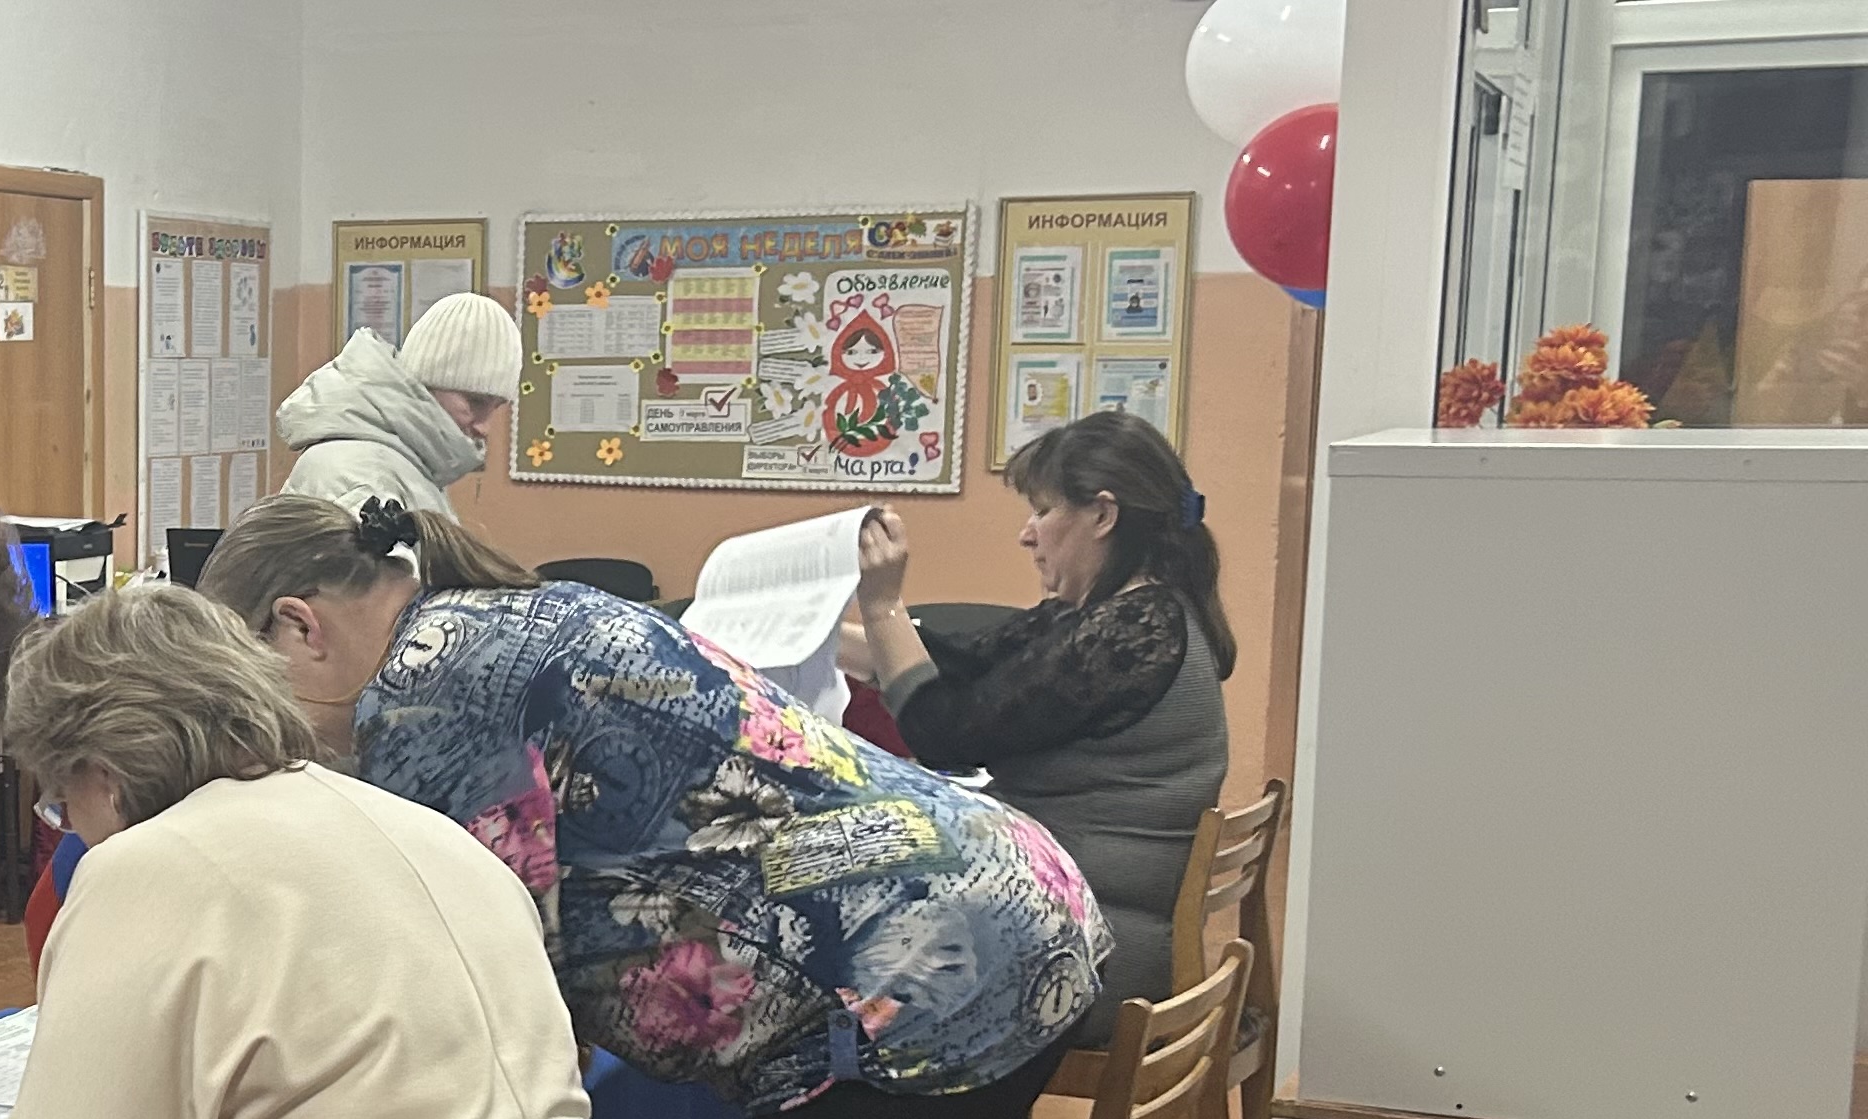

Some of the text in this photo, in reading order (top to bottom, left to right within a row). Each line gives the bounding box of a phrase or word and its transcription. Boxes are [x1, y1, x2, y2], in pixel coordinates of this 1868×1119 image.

[1027, 211, 1168, 230] ИНФОРМАЦИЯ
[354, 234, 466, 251] ИНФОРМАЦИЯ
[659, 229, 863, 262] МОЯ НЕДЕЛЯ
[837, 272, 950, 295] Объявление
[646, 407, 674, 420] ДЕНЬ
[646, 421, 742, 433] САМОУПРАВЛЕНИЯ
[834, 454, 920, 481] Марта!
